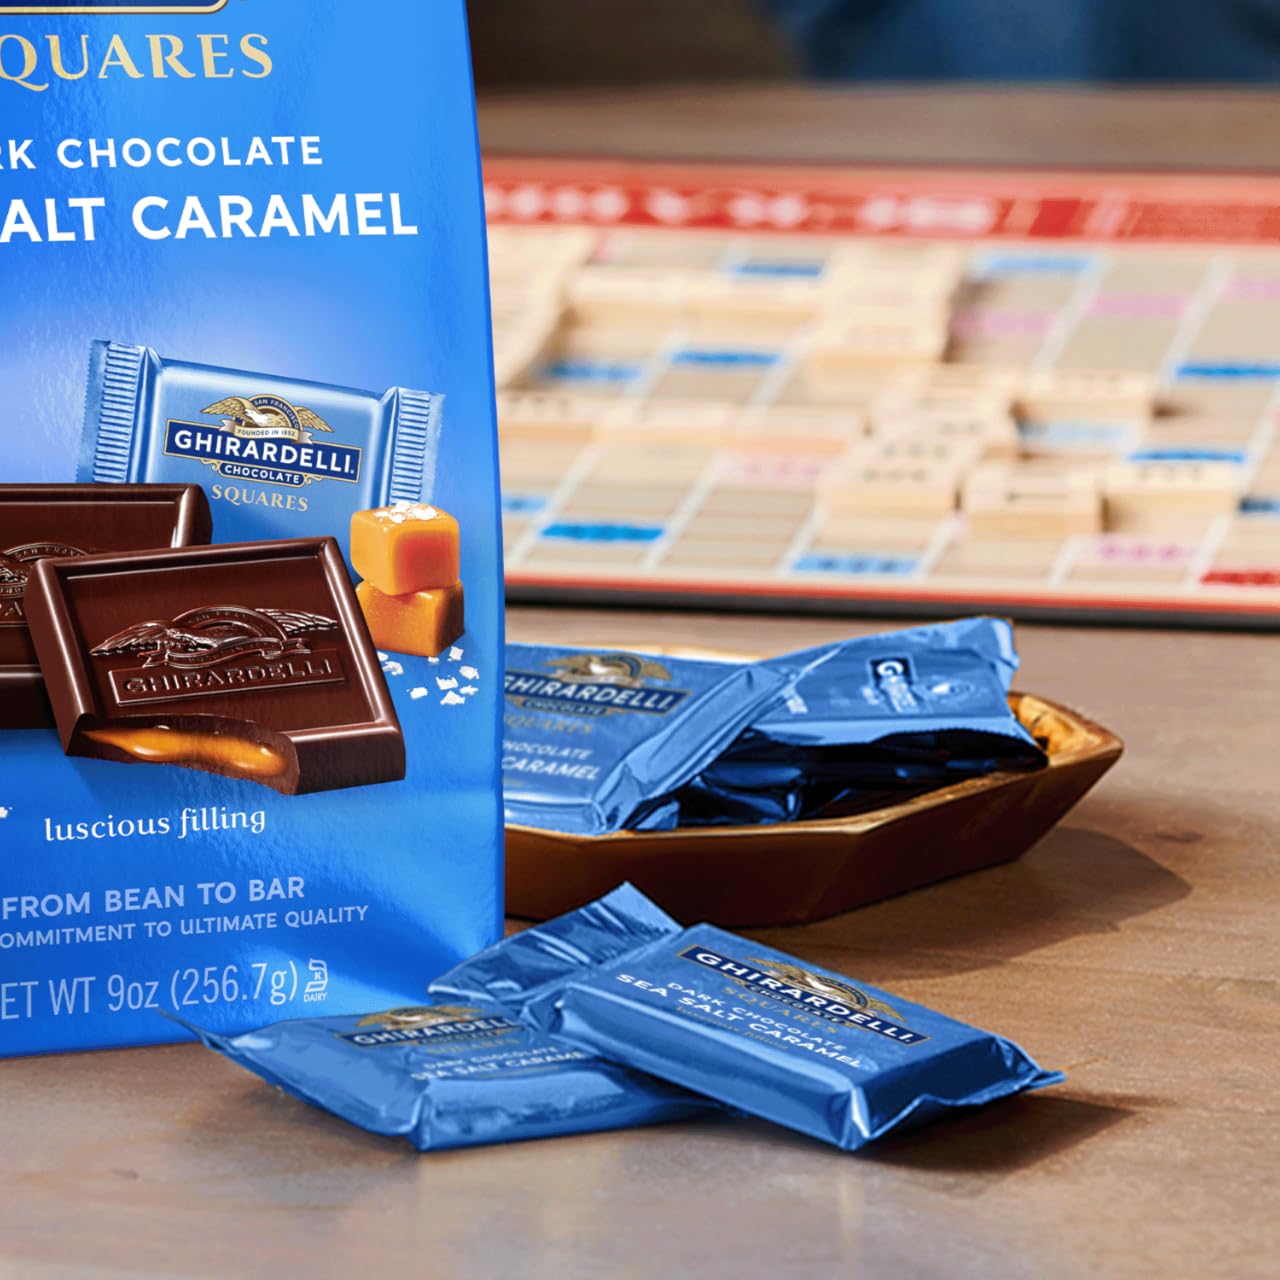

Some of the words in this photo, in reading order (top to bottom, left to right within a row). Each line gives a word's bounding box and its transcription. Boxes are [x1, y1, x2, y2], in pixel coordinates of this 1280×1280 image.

[57, 135, 323, 169] CHOCOLATE
[131, 192, 419, 239] CARAMEL
[175, 429, 352, 474] GHIRARDELLI
[224, 464, 300, 484] CHOCOLATE
[212, 484, 308, 511] SQUARES
[125, 659, 332, 693] GHIRARDELLI
[502, 740, 593, 759] HOCOLATE
[45, 814, 170, 841] luscious
[178, 806, 265, 839] filling
[2, 892, 91, 920] FROM
[104, 885, 185, 912] BEAN
[197, 881, 237, 906] TO
[249, 876, 305, 902] BAR
[145, 921, 172, 939] TO
[180, 912, 277, 937] ULTIMATE
[285, 905, 368, 929] QUALITY
[48, 977, 96, 1015] WT
[107, 974, 159, 1010] 9oz
[171, 959, 298, 1010] (256.7g)
[304, 992, 327, 1002] DAIRY
[695, 952, 912, 1043] GHIRARDELLI
[616, 974, 669, 997] SEA
[678, 997, 745, 1022] SALT
[748, 1022, 862, 1068] CARAMEL
[667, 982, 726, 1007] DARK
[731, 1006, 848, 1051] CHOCOLATE
[454, 1059, 499, 1075] SALT
